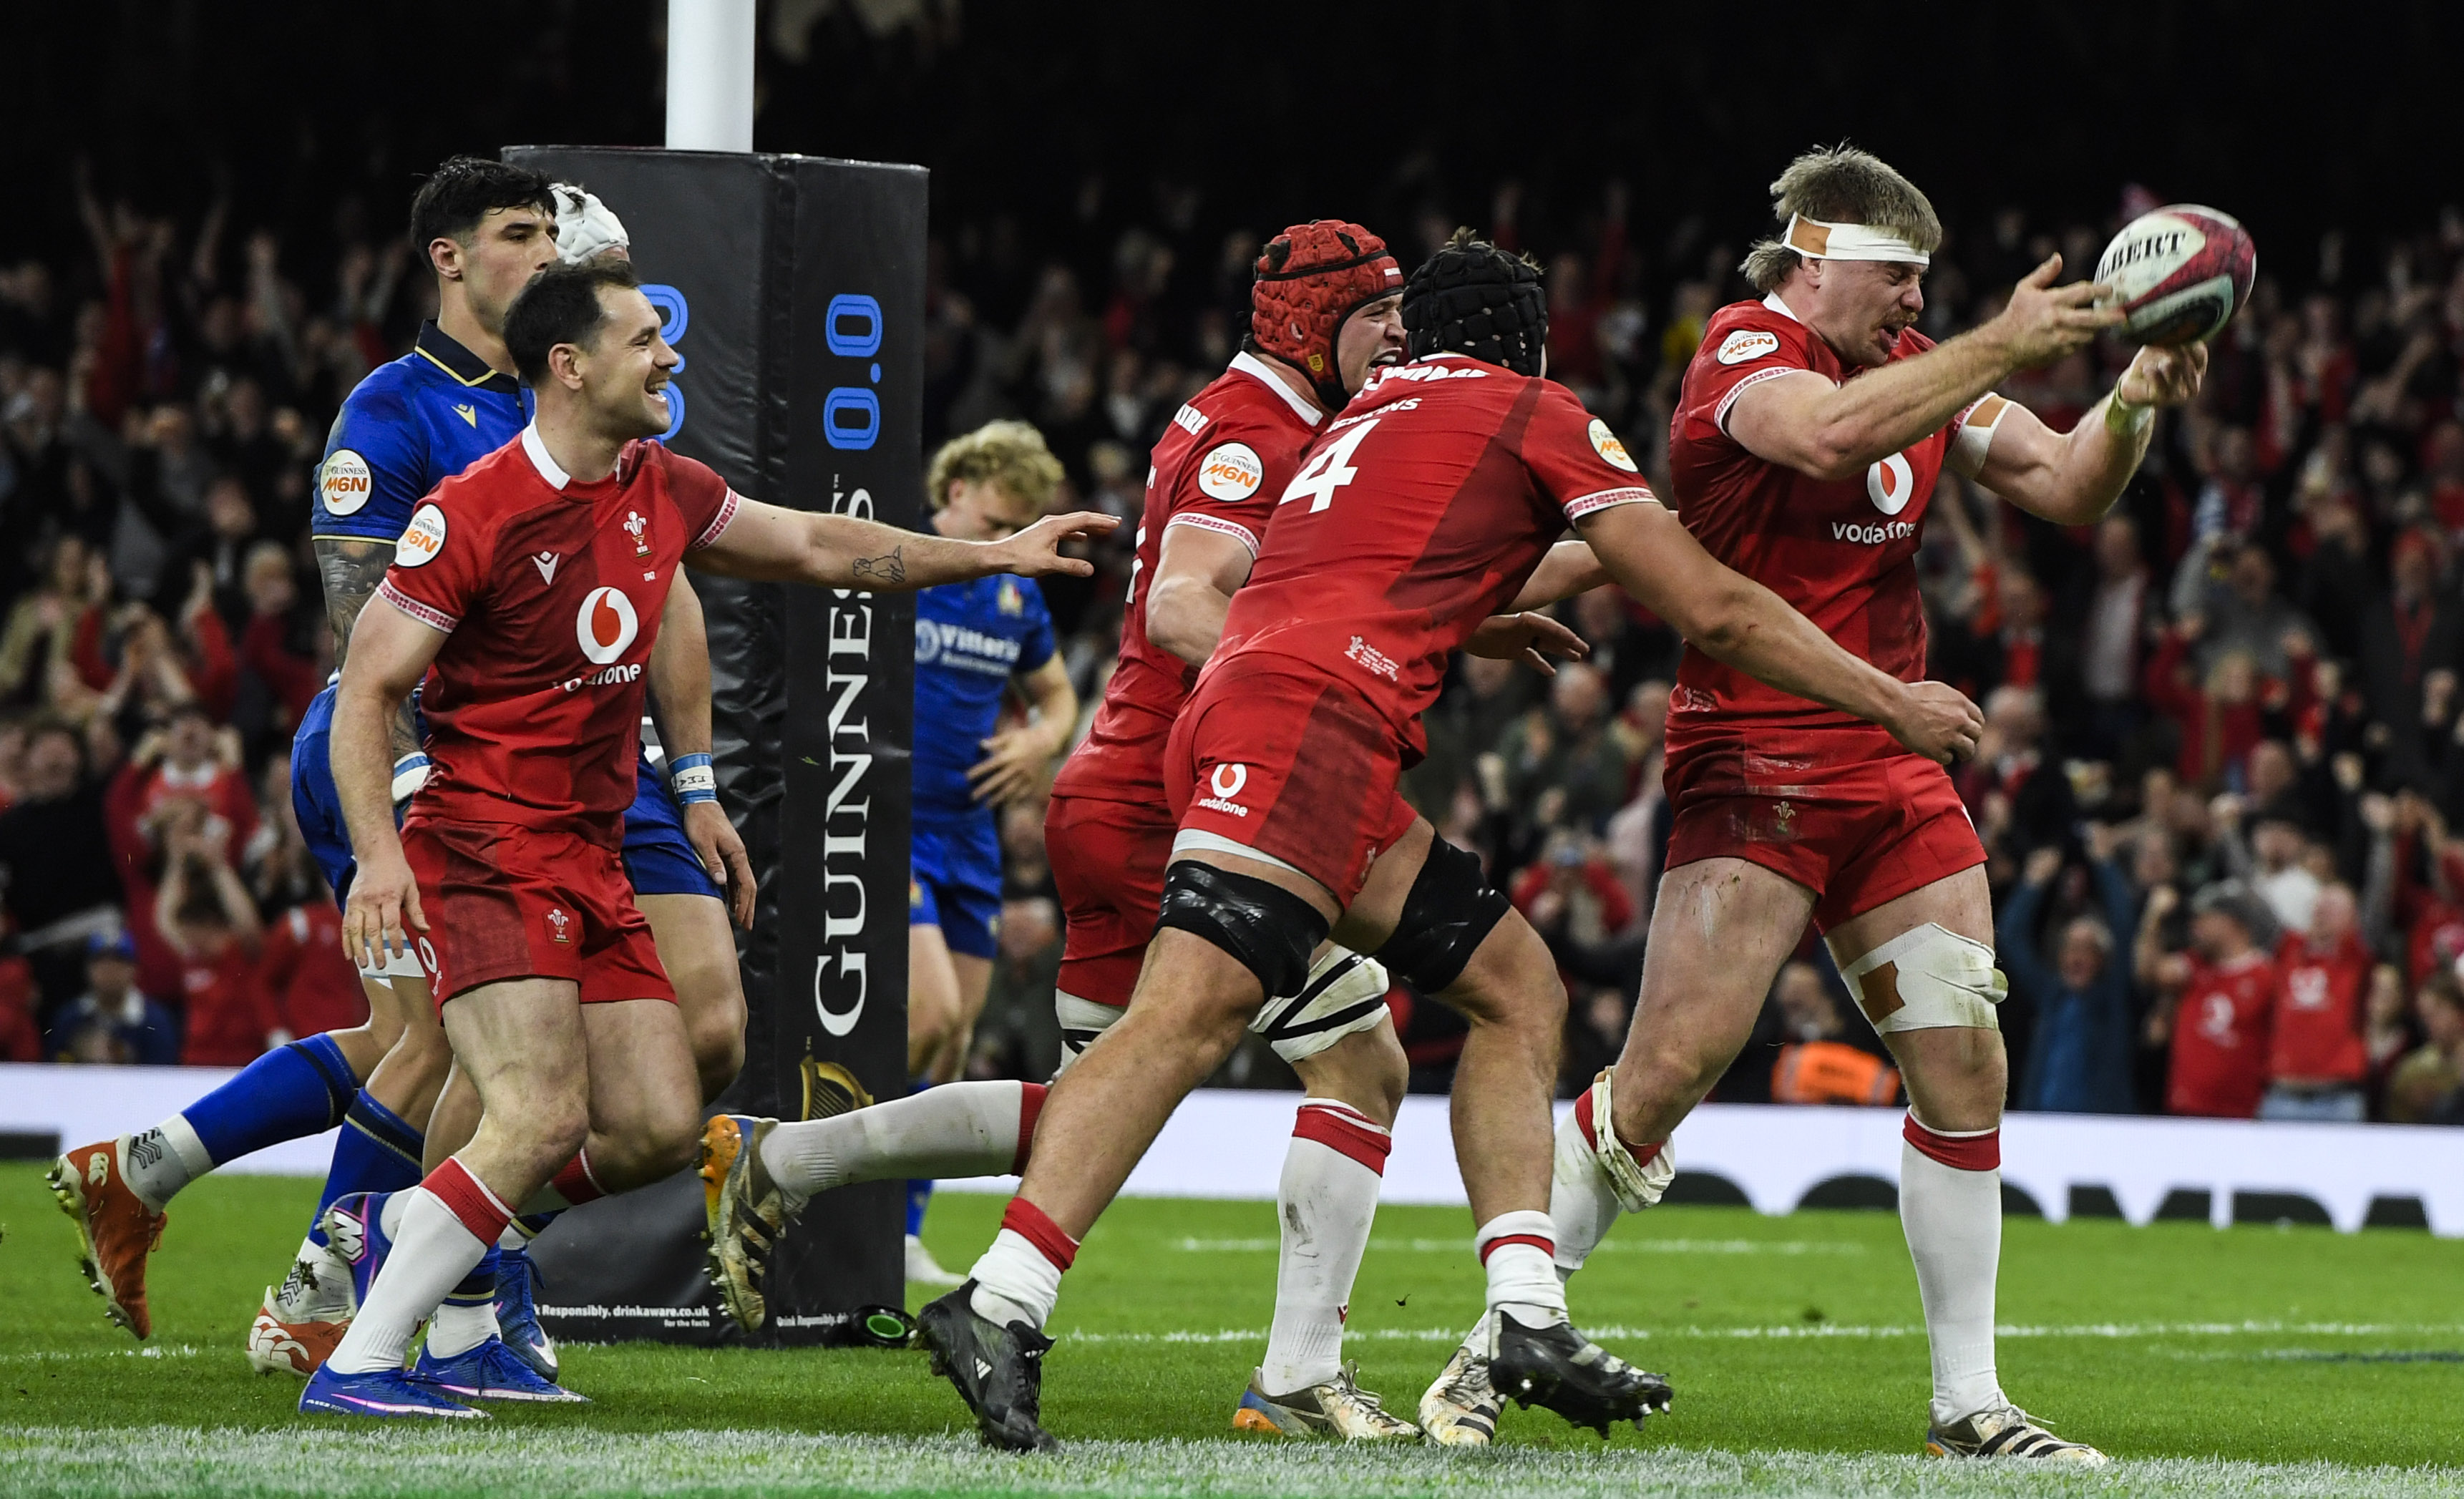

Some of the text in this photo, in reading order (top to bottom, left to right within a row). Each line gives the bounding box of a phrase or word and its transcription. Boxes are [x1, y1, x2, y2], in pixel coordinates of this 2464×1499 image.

[2096, 230, 2187, 284] LBERT
[823, 293, 883, 450] 0.0
[331, 466, 367, 475] GUINNESS
[1201, 462, 1258, 488] M6N
[1220, 454, 1261, 474] GUINNESS
[1279, 419, 1381, 514] 4
[322, 477, 368, 493] M6N
[814, 488, 874, 1036] GUINNES
[1197, 796, 1249, 817] vodafone
[542, 1304, 611, 1319] Responsibly.
[613, 1304, 710, 1317] drinkaware.co.uk
